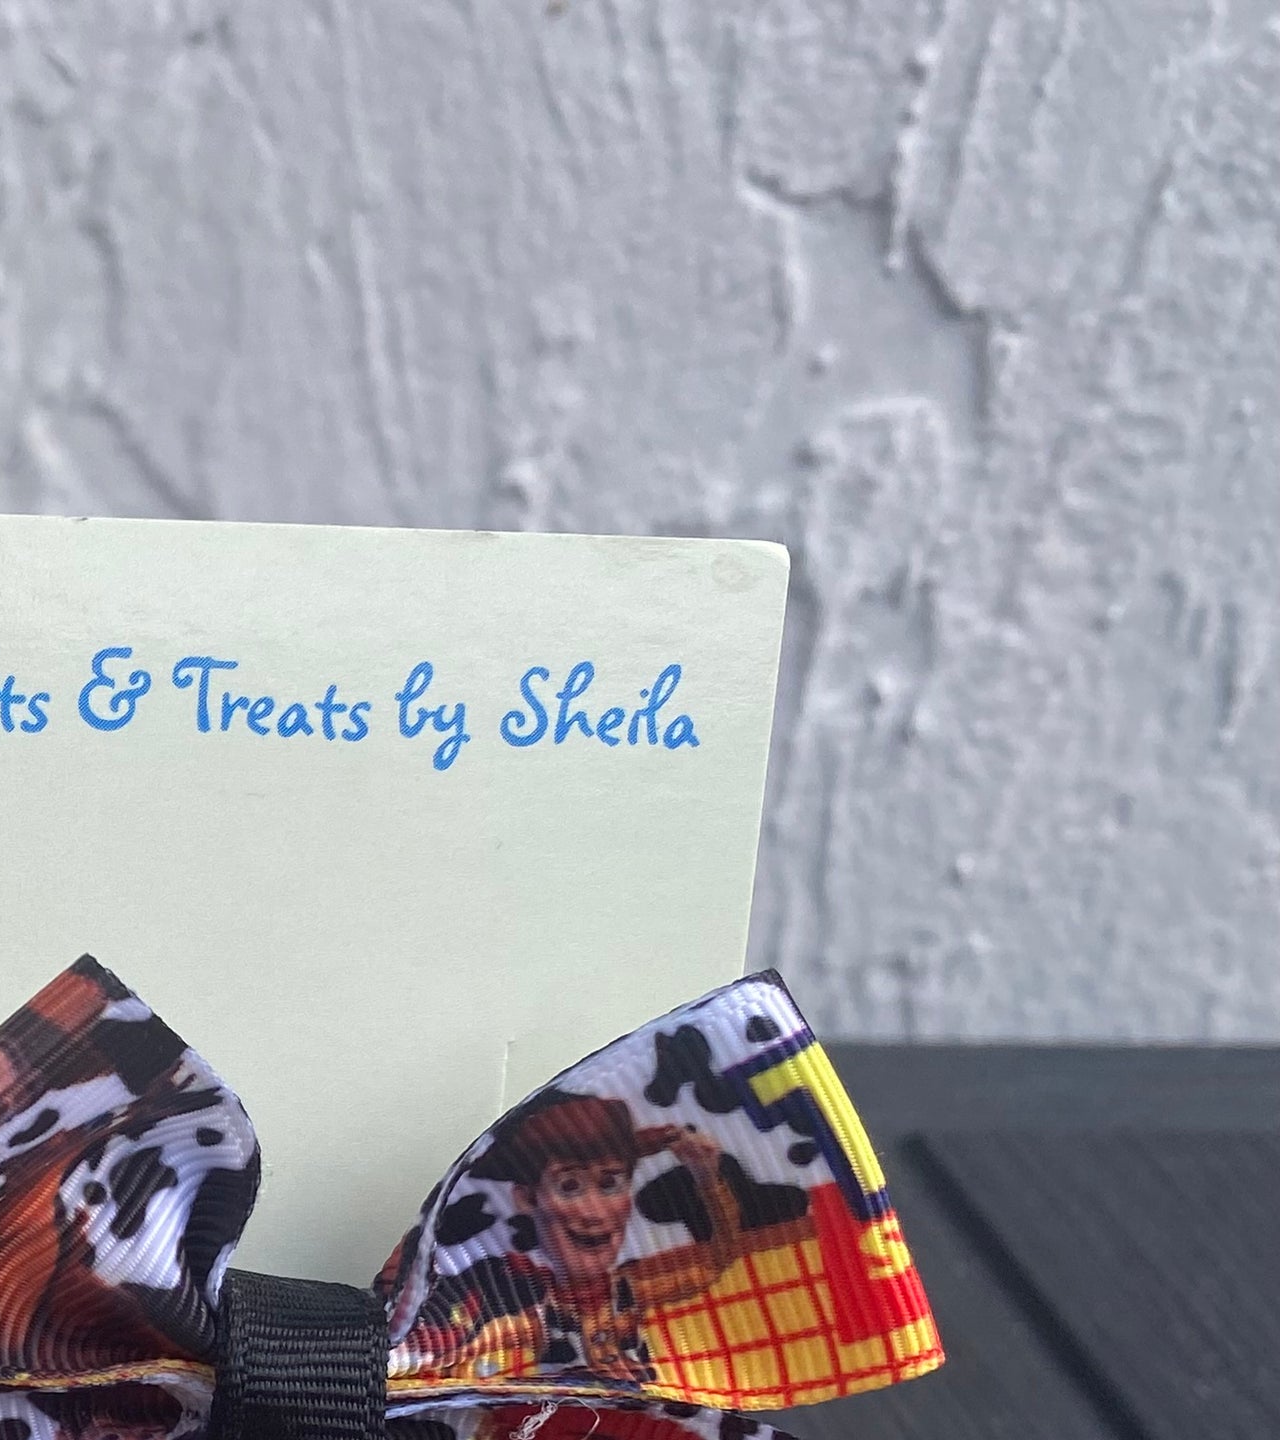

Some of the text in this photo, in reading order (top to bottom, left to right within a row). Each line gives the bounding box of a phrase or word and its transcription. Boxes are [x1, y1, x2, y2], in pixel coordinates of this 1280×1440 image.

[76, 645, 153, 732] &
[171, 655, 373, 743] Treats
[394, 660, 472, 772] by
[499, 659, 701, 751] Sheila
